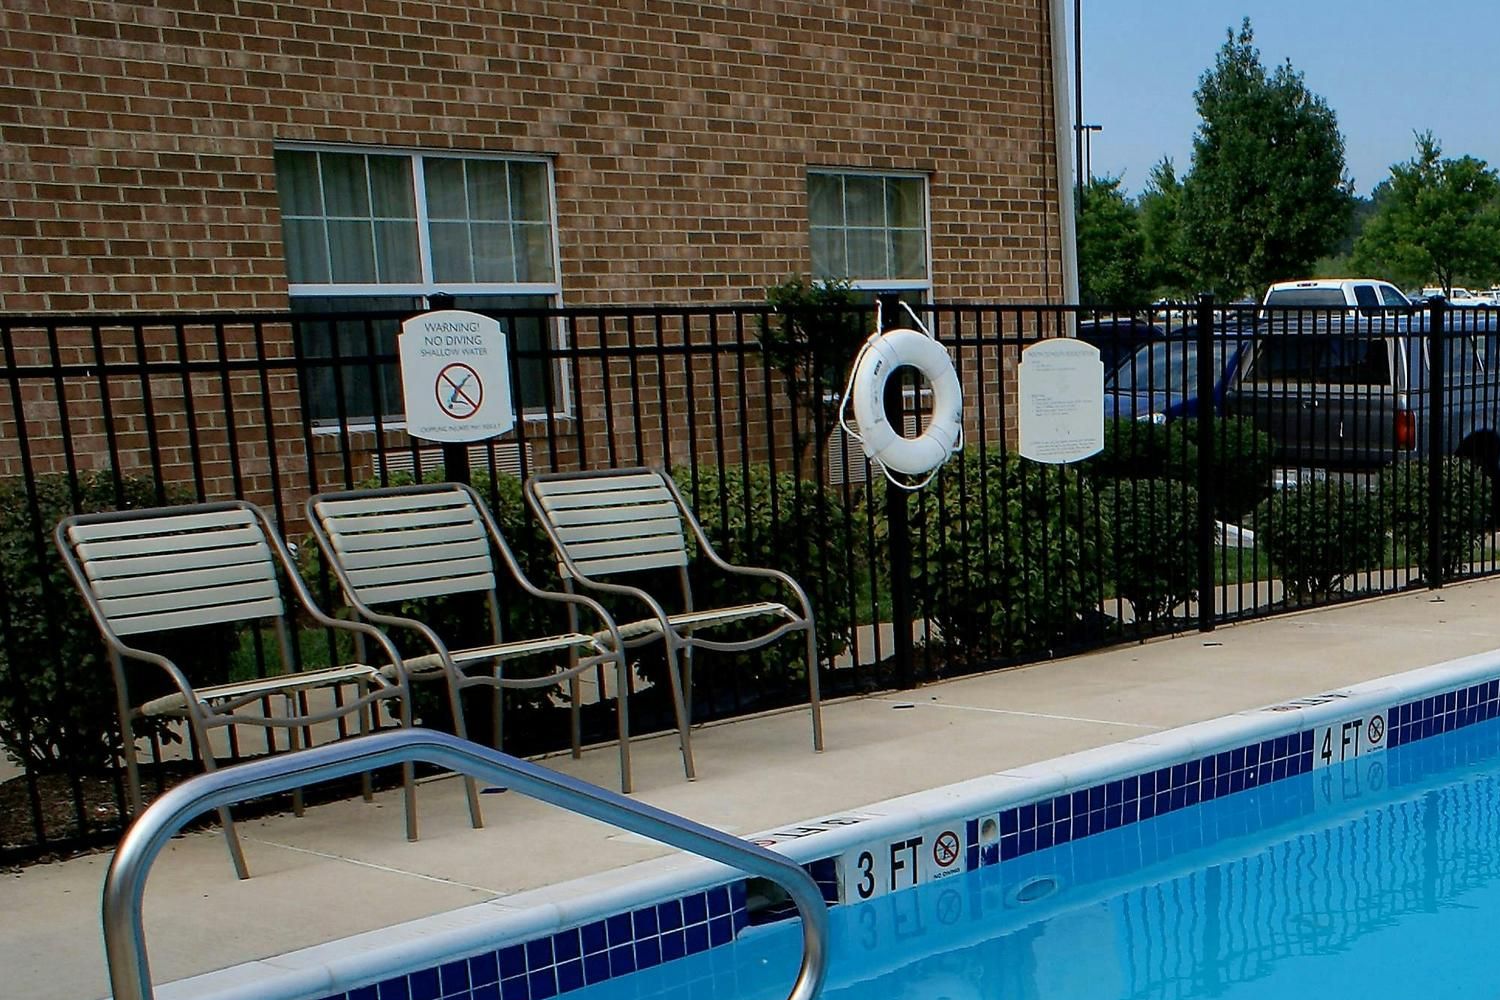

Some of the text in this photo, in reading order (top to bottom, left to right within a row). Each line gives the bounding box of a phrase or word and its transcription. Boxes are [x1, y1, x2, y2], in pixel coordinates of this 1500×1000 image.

[424, 322, 480, 332] WARNING!
[424, 336, 482, 346] NO DIVING
[420, 347, 488, 357] SHALLOW WATER
[1321, 719, 1363, 765] 4 FT
[857, 836, 923, 899] 3 FT
